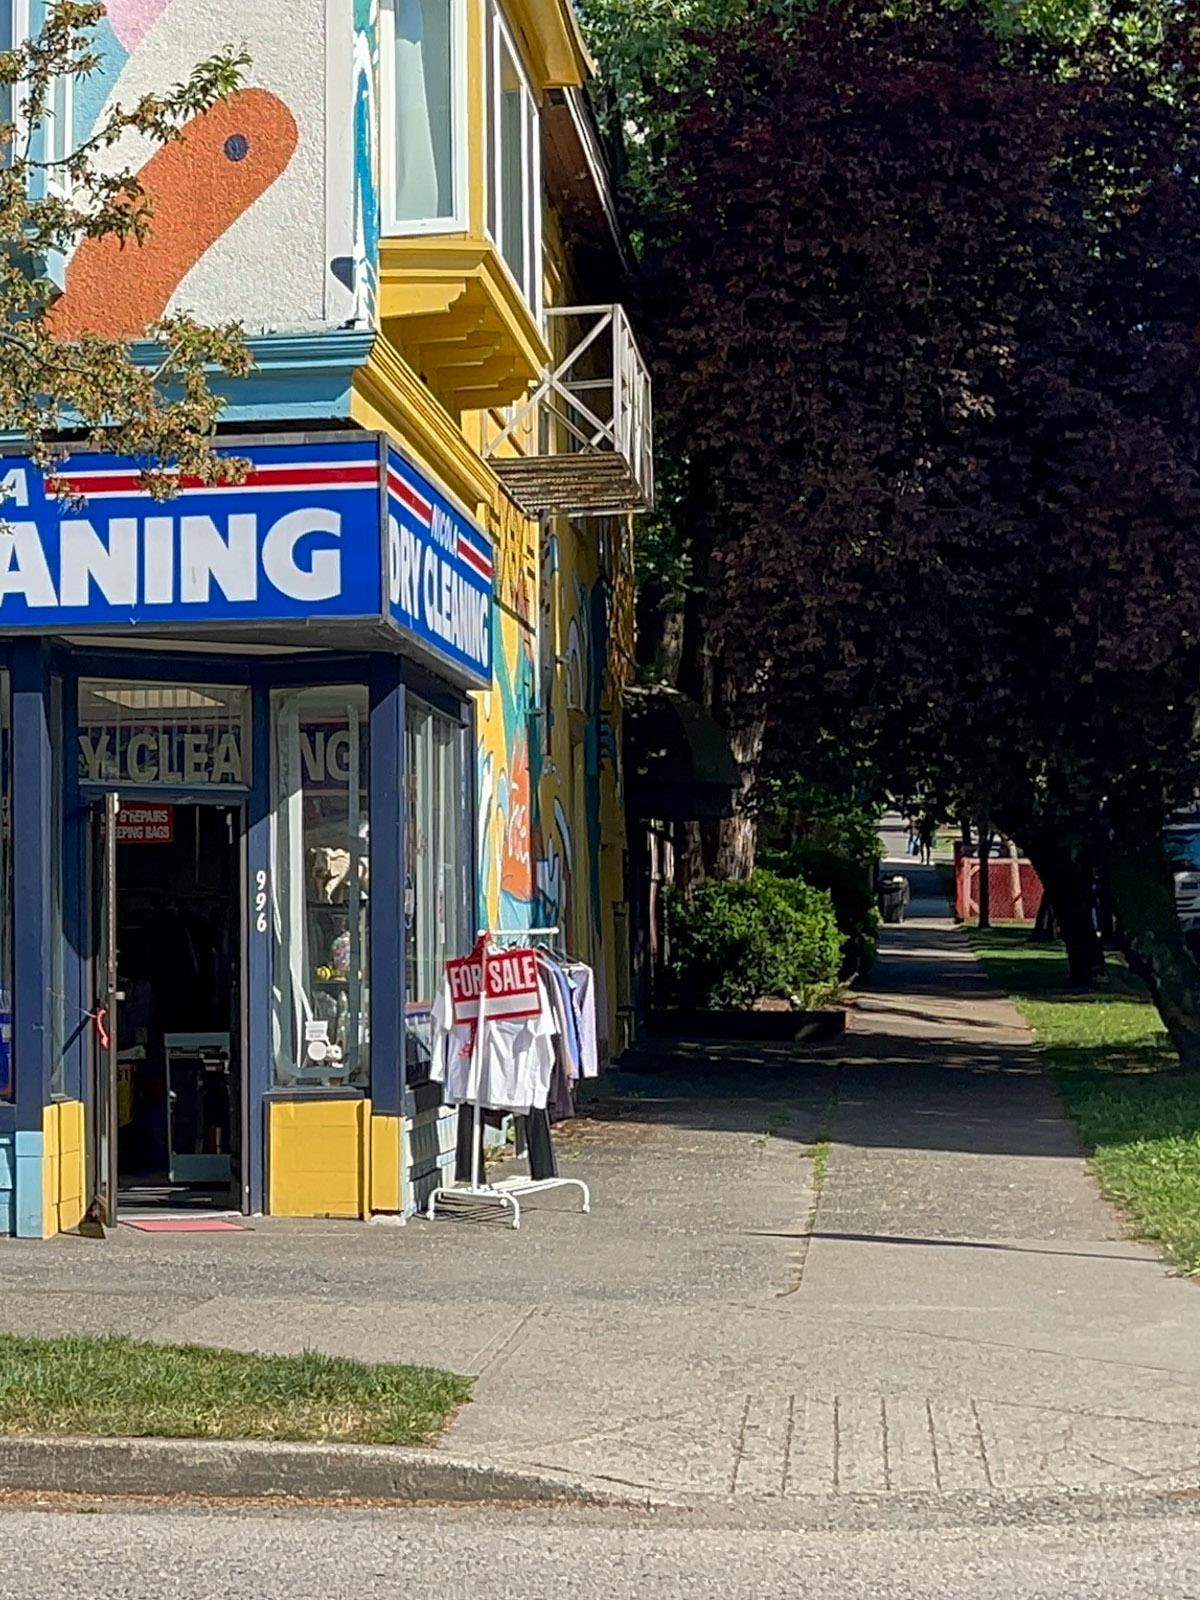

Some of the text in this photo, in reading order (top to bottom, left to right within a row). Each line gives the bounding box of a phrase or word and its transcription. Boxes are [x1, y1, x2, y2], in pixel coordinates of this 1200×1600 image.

[431, 503, 459, 559] NICOLA
[388, 514, 489, 669] DRY CLEANING
[256, 870, 267, 932] 996
[450, 956, 536, 998] FOR SALE
